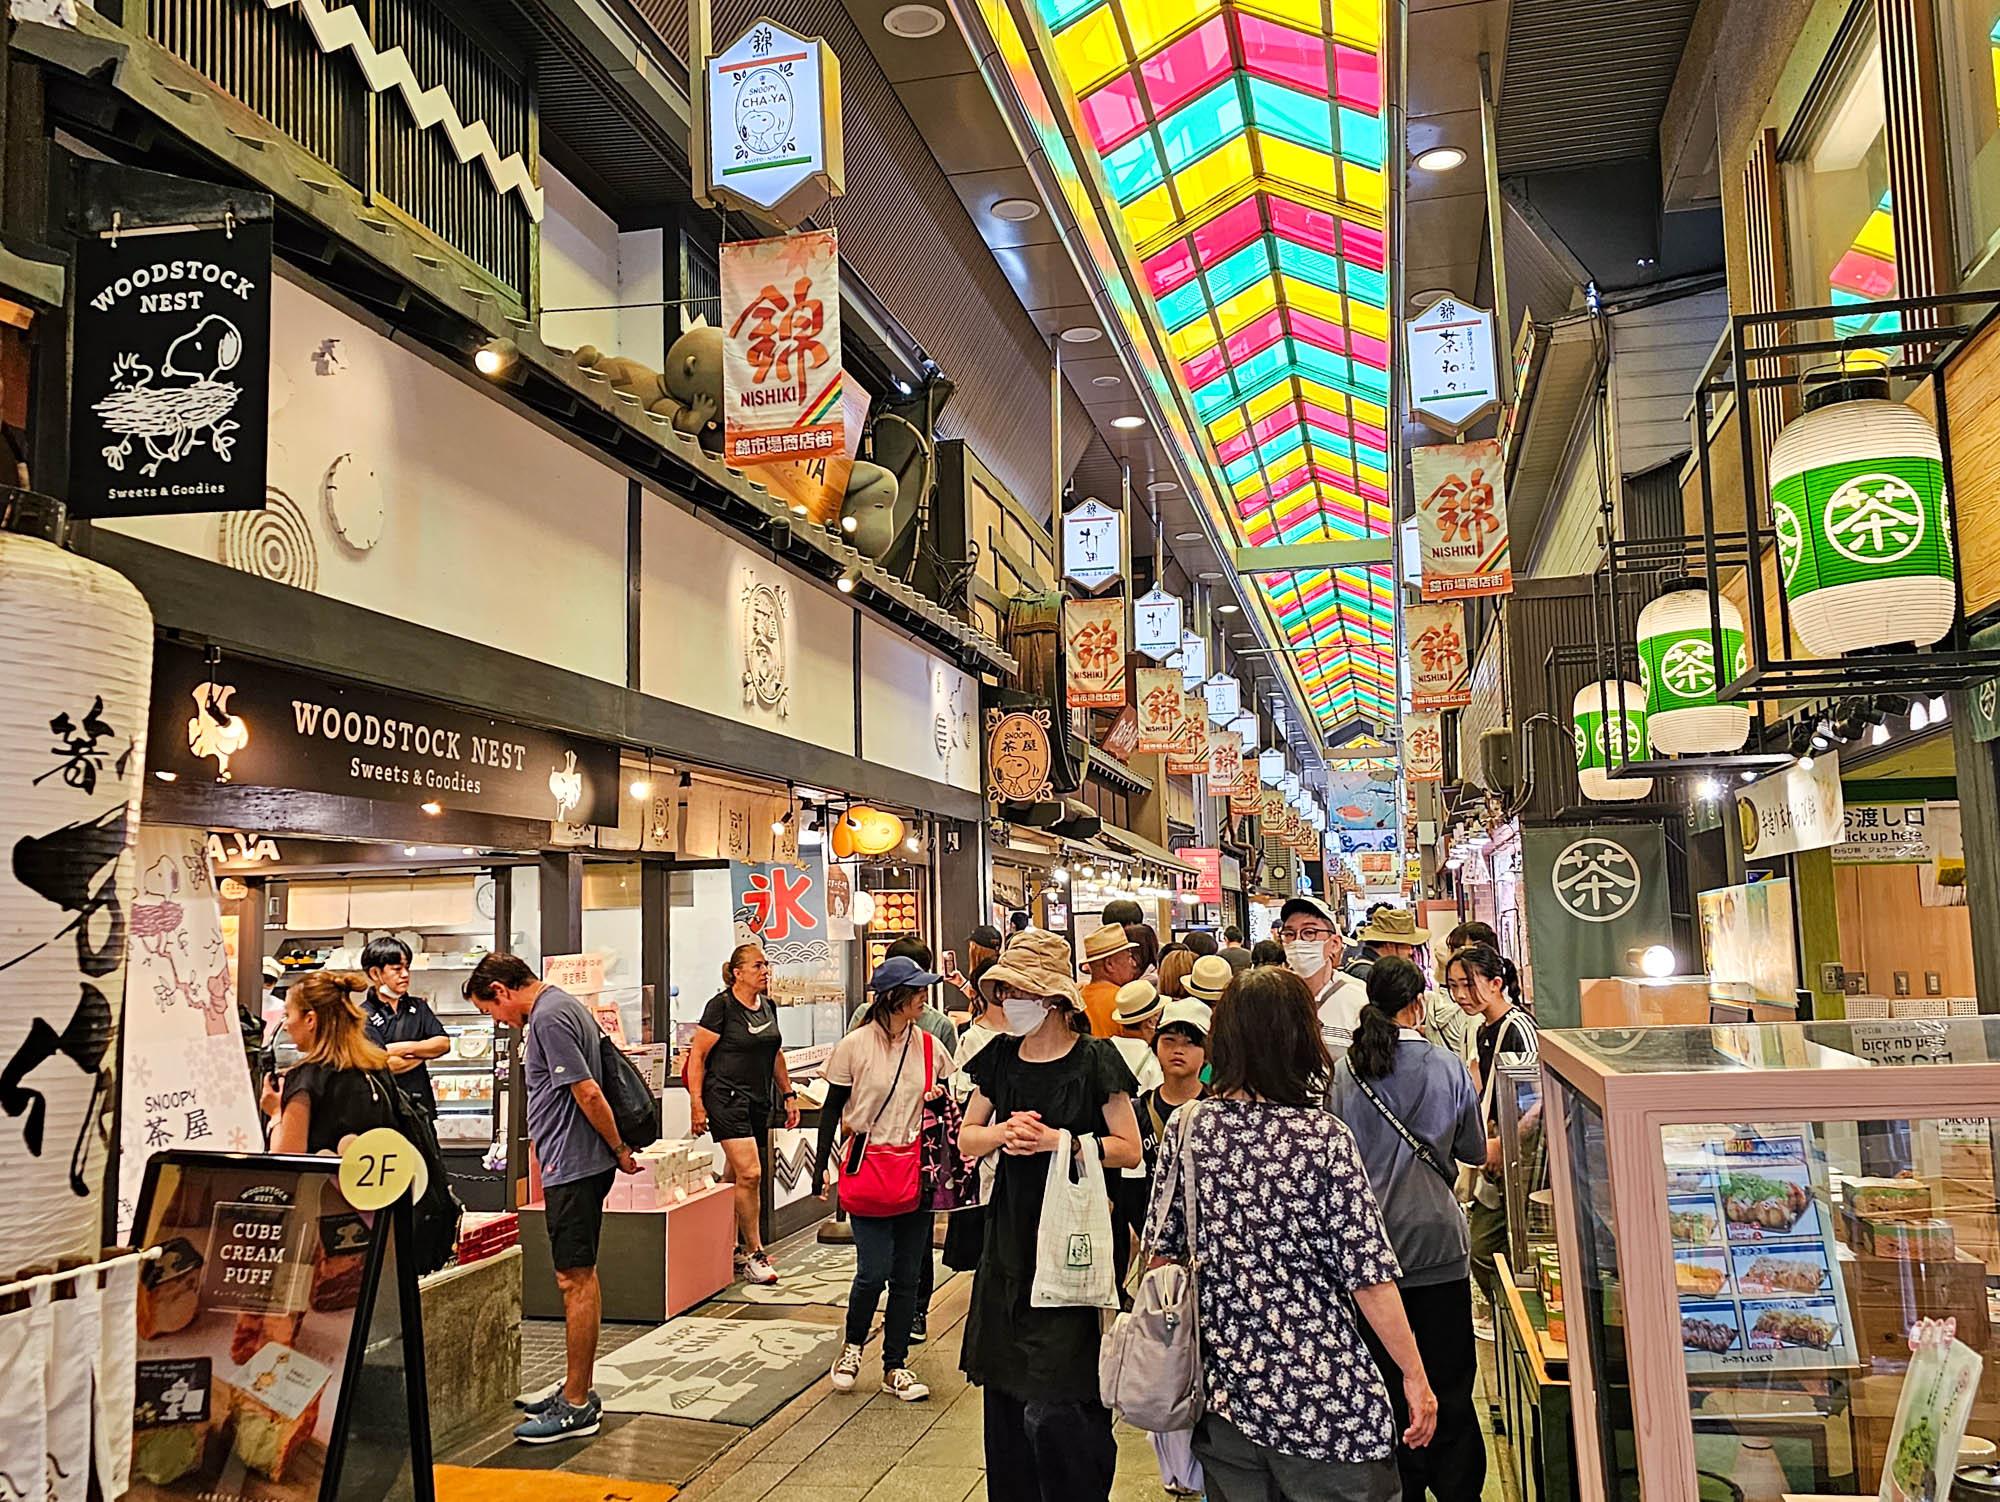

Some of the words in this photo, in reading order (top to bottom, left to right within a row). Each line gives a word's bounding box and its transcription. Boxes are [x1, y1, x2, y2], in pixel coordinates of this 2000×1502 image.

[742, 93, 787, 109] CHA-YA
[749, 83, 777, 96] SNOOPY
[90, 260, 255, 312] WOODSTOCK
[140, 291, 204, 314] NEST
[729, 276, 830, 406] 錦
[740, 386, 797, 408] NISHIKI
[735, 430, 833, 456] 錦市場商店街
[108, 486, 157, 499] Sweets
[160, 486, 169, 496] &
[171, 483, 225, 496] Goodies
[1421, 467, 1500, 558] 錦
[1829, 484, 1920, 552] 茶
[1431, 544, 1476, 559] NISHIKI
[1069, 618, 1118, 681] 錦
[1411, 622, 1464, 682] 錦
[1073, 669, 1103, 680] NISHIKI
[1418, 672, 1448, 683] NISHIKI
[1664, 645, 1715, 691] 茶
[291, 700, 462, 761] WOODSTOCK
[471, 737, 527, 772] NEST
[1004, 730, 1033, 740] SNOOPY
[350, 757, 409, 786] Sweets
[412, 768, 423, 785] &
[426, 769, 482, 795] Goodies
[1843, 807, 1926, 828] お渡し口
[1844, 830, 1867, 842] ick
[1870, 832, 1888, 844] up
[1891, 829, 1923, 842] here
[1557, 848, 1636, 911] 茶
[742, 868, 817, 940] 氷
[145, 1087, 198, 1113] SNOOPY
[143, 1107, 213, 1149] 茶屋
[356, 1154, 398, 1188] 2F
[240, 1185, 289, 1202] WOODSTOCK
[232, 1223, 283, 1240] CUBE
[220, 1244, 286, 1264] CREAM
[223, 1266, 273, 1285] PUFF
